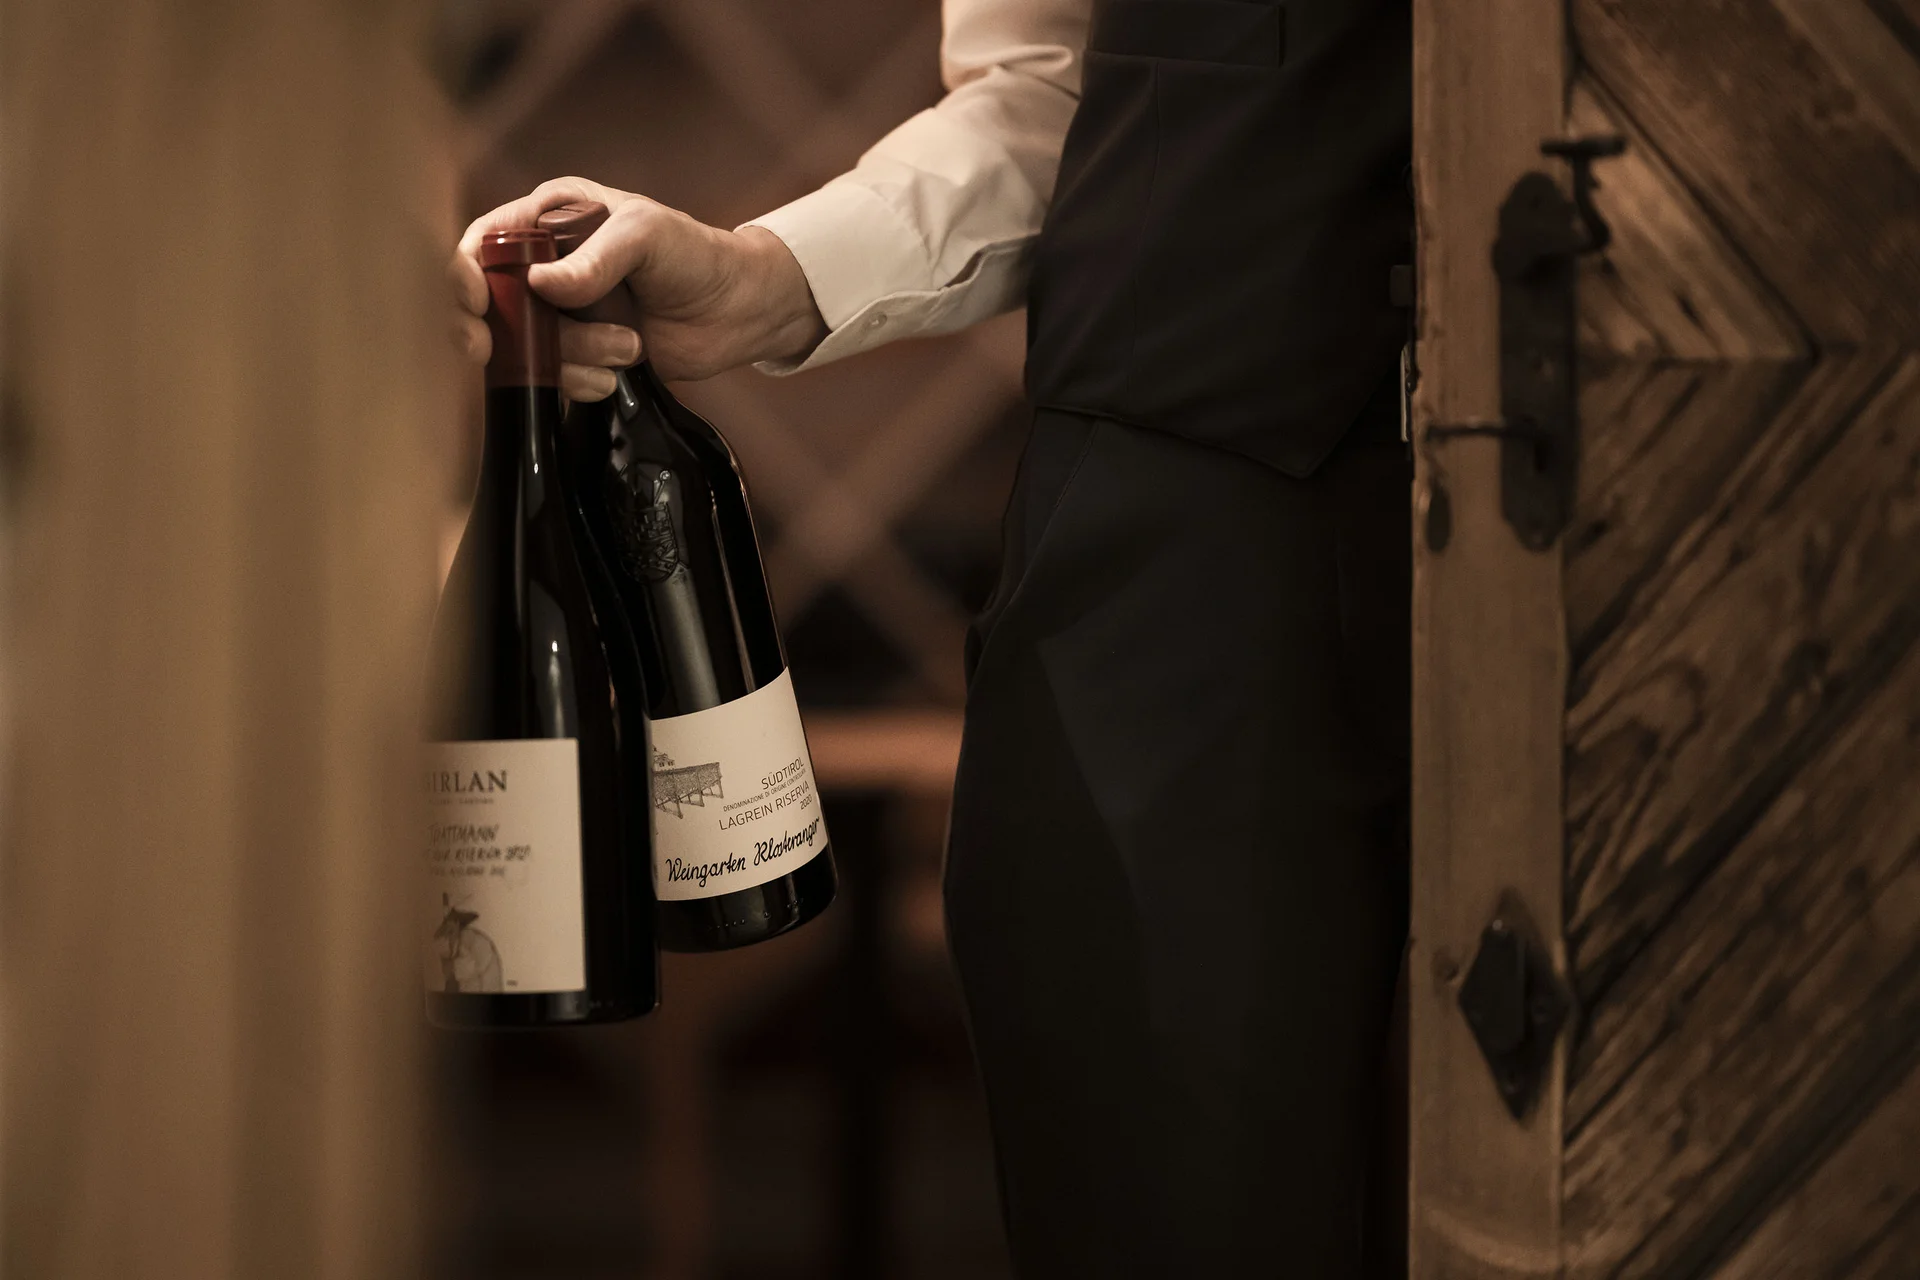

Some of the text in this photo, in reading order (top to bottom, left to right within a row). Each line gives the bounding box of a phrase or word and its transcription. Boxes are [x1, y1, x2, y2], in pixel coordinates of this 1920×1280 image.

[761, 757, 805, 790] SÜDTIROL
[718, 780, 810, 831] LAGREIN RISERVA
[722, 793, 765, 812] DENOMINAZIONE
[799, 794, 813, 811] 2020
[665, 816, 820, 888] Weingarten Klosteranger
